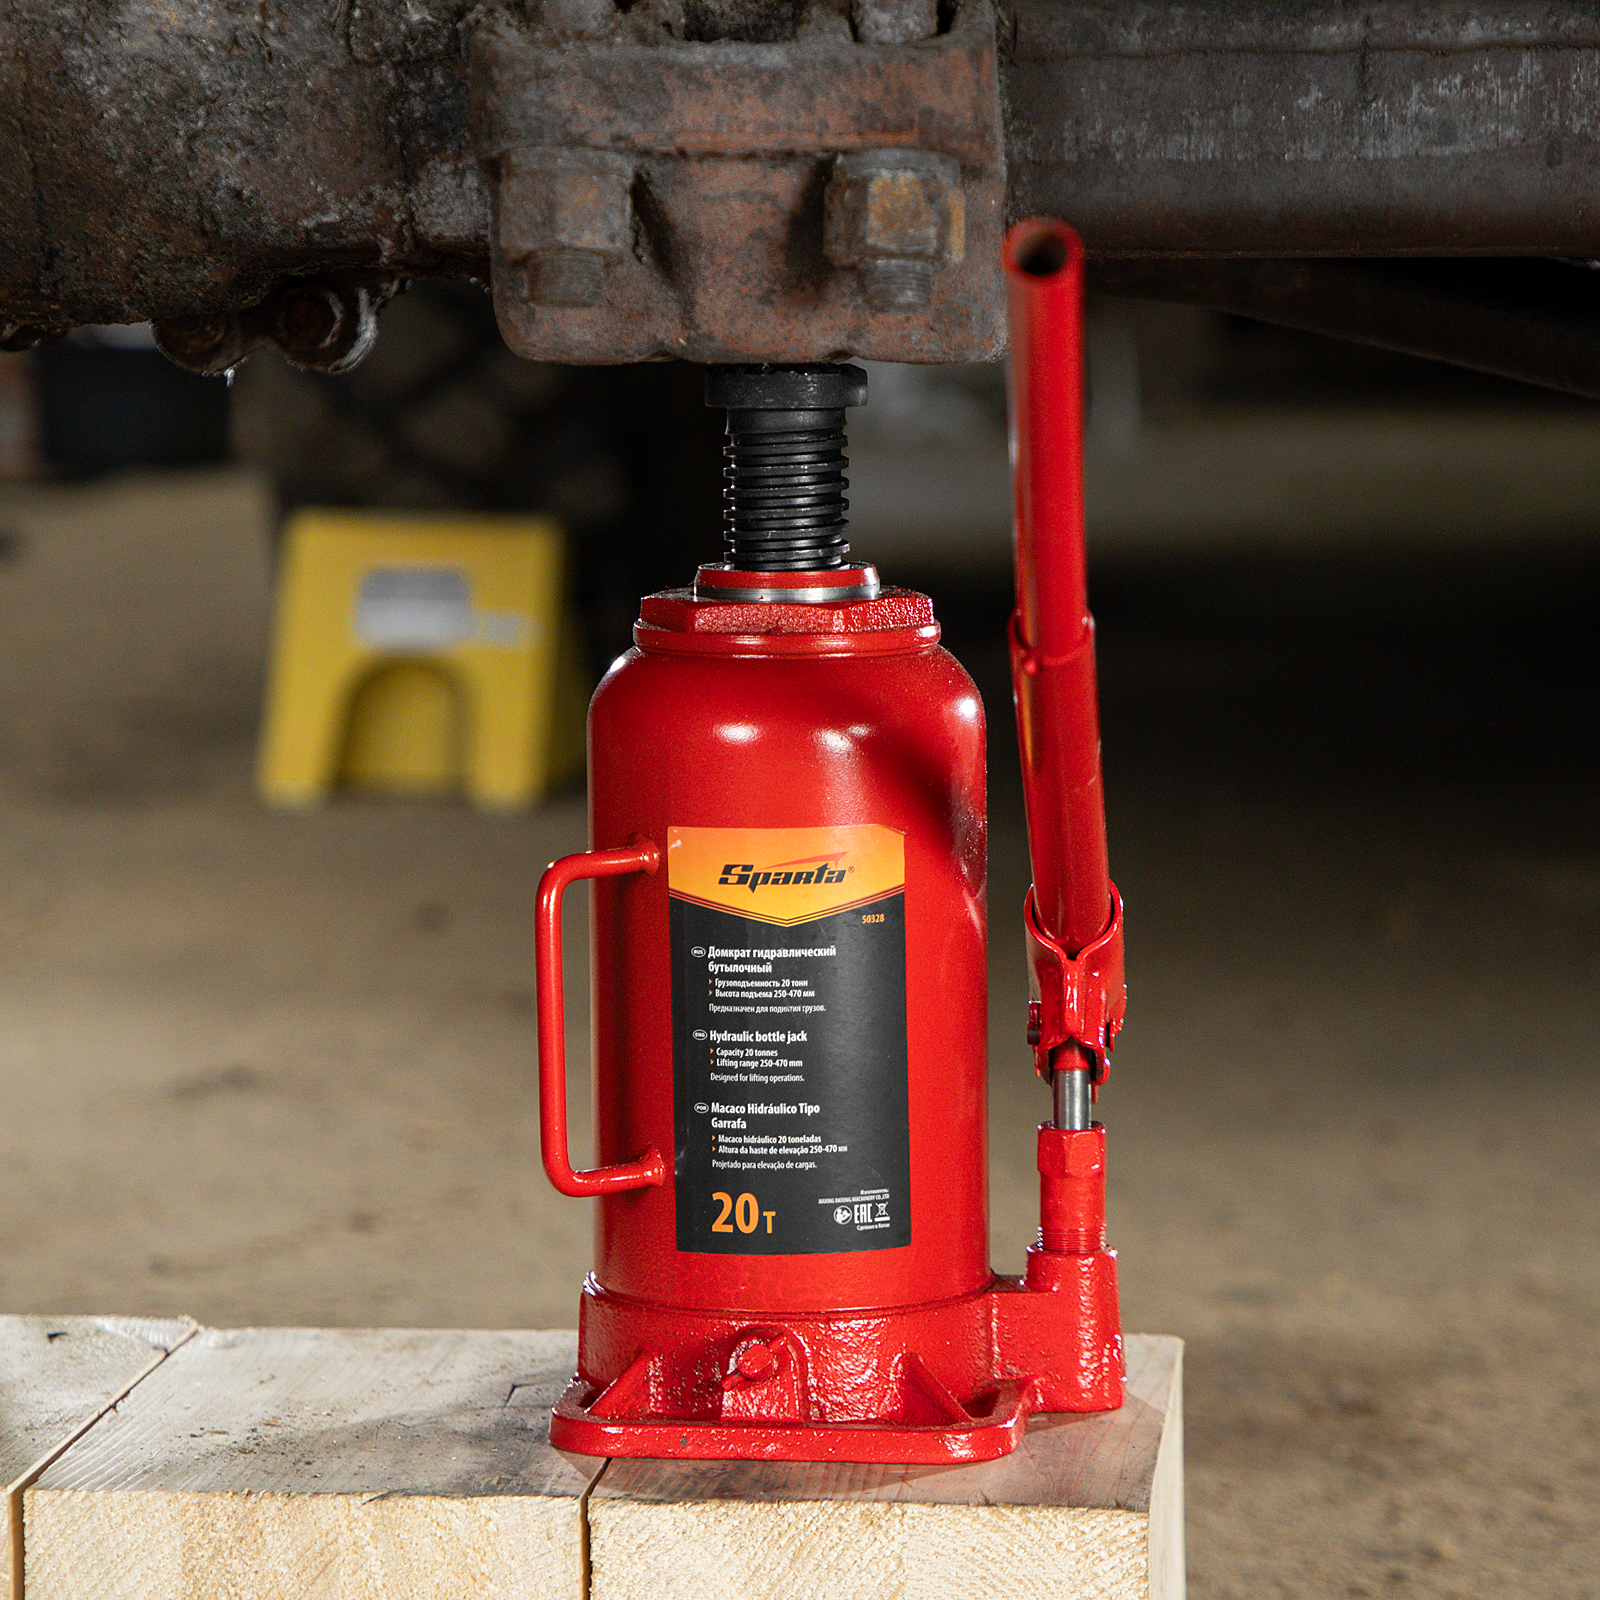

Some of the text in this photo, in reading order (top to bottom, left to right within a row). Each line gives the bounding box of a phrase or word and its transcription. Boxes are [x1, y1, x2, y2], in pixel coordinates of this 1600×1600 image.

[861, 913, 885, 924] 50328
[708, 945, 837, 960] Домкрат гидравлический
[708, 961, 772, 974] бутылочный
[715, 978, 779, 988] Грузоподъемность
[715, 989, 739, 997] Высота
[709, 1003, 754, 1013] Предназначен
[710, 1030, 807, 1044] Hydraulic bottle jack
[716, 1048, 744, 1058] Capacity
[755, 1049, 778, 1057] tonnes
[717, 1059, 738, 1069] Lifting
[739, 1061, 758, 1069] range
[760, 1059, 787, 1067] 250-470
[711, 1073, 805, 1084] Designed for lifting operations.
[711, 1102, 820, 1116] Macaco Hidráulico Tipo
[711, 1117, 746, 1129] Garrafa
[718, 1135, 742, 1143] Macaco
[788, 1135, 821, 1143] toneladas
[718, 1145, 738, 1153] Altura
[740, 1146, 748, 1154] da
[749, 1146, 767, 1154] haste
[779, 1146, 808, 1155] elevação
[810, 1145, 837, 1153] 250-470
[712, 1160, 741, 1169] Projetado
[742, 1162, 756, 1170] para
[757, 1160, 784, 1170] elevação
[795, 1161, 817, 1170] cargas.
[712, 1192, 759, 1233] 20
